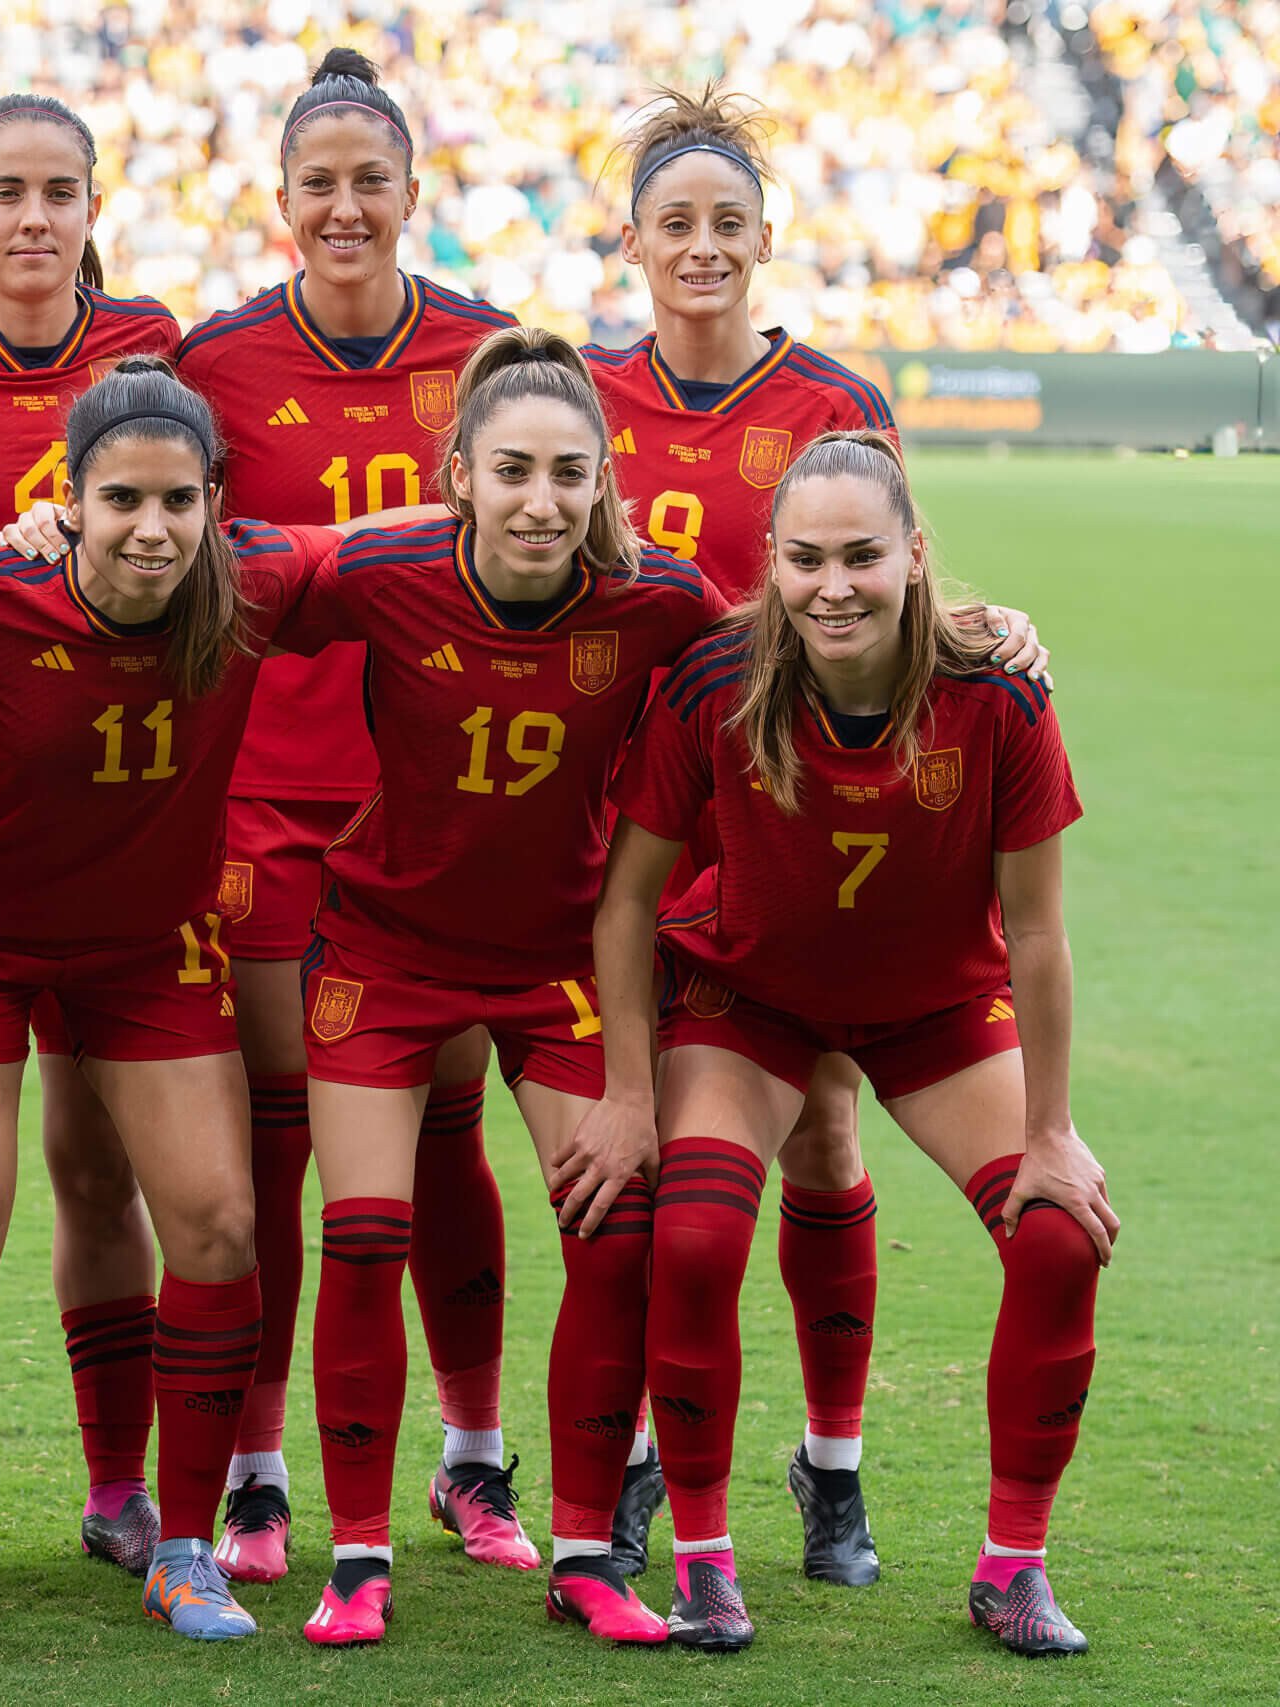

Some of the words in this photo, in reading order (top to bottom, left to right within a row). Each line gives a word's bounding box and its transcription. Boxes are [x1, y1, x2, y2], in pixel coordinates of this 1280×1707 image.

[14, 441, 69, 514] 4
[319, 453, 420, 525] 10
[92, 699, 179, 783] 11
[456, 706, 566, 796] 19
[832, 831, 889, 909] 7
[548, 976, 602, 1040] 1
